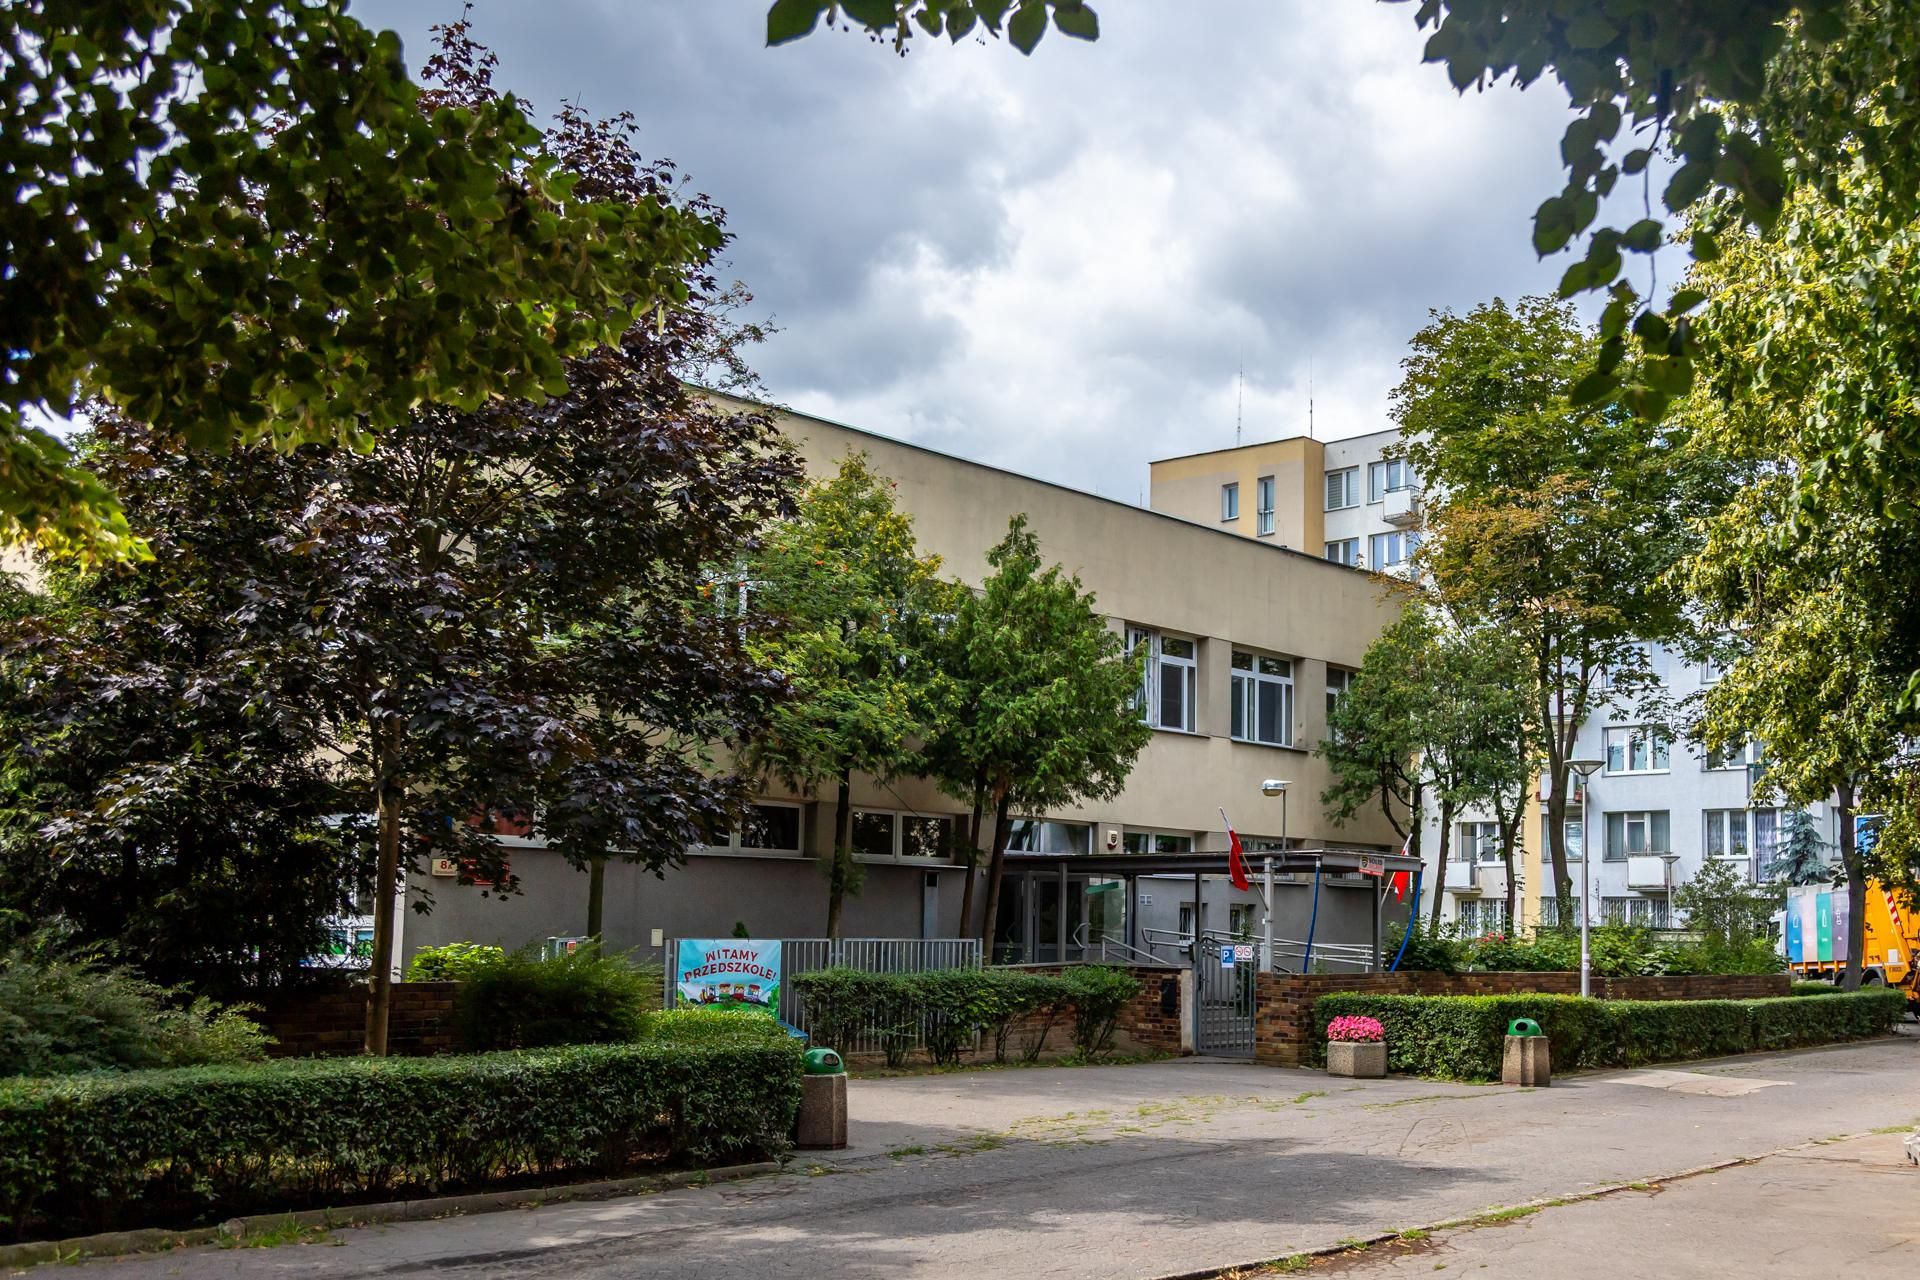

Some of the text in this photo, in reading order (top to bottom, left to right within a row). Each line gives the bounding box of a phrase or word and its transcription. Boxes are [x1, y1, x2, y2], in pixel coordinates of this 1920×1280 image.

[705, 949, 759, 963] WITAMY
[1223, 950, 1229, 960] P
[684, 962, 777, 982] PRZEDSZKOLE!
